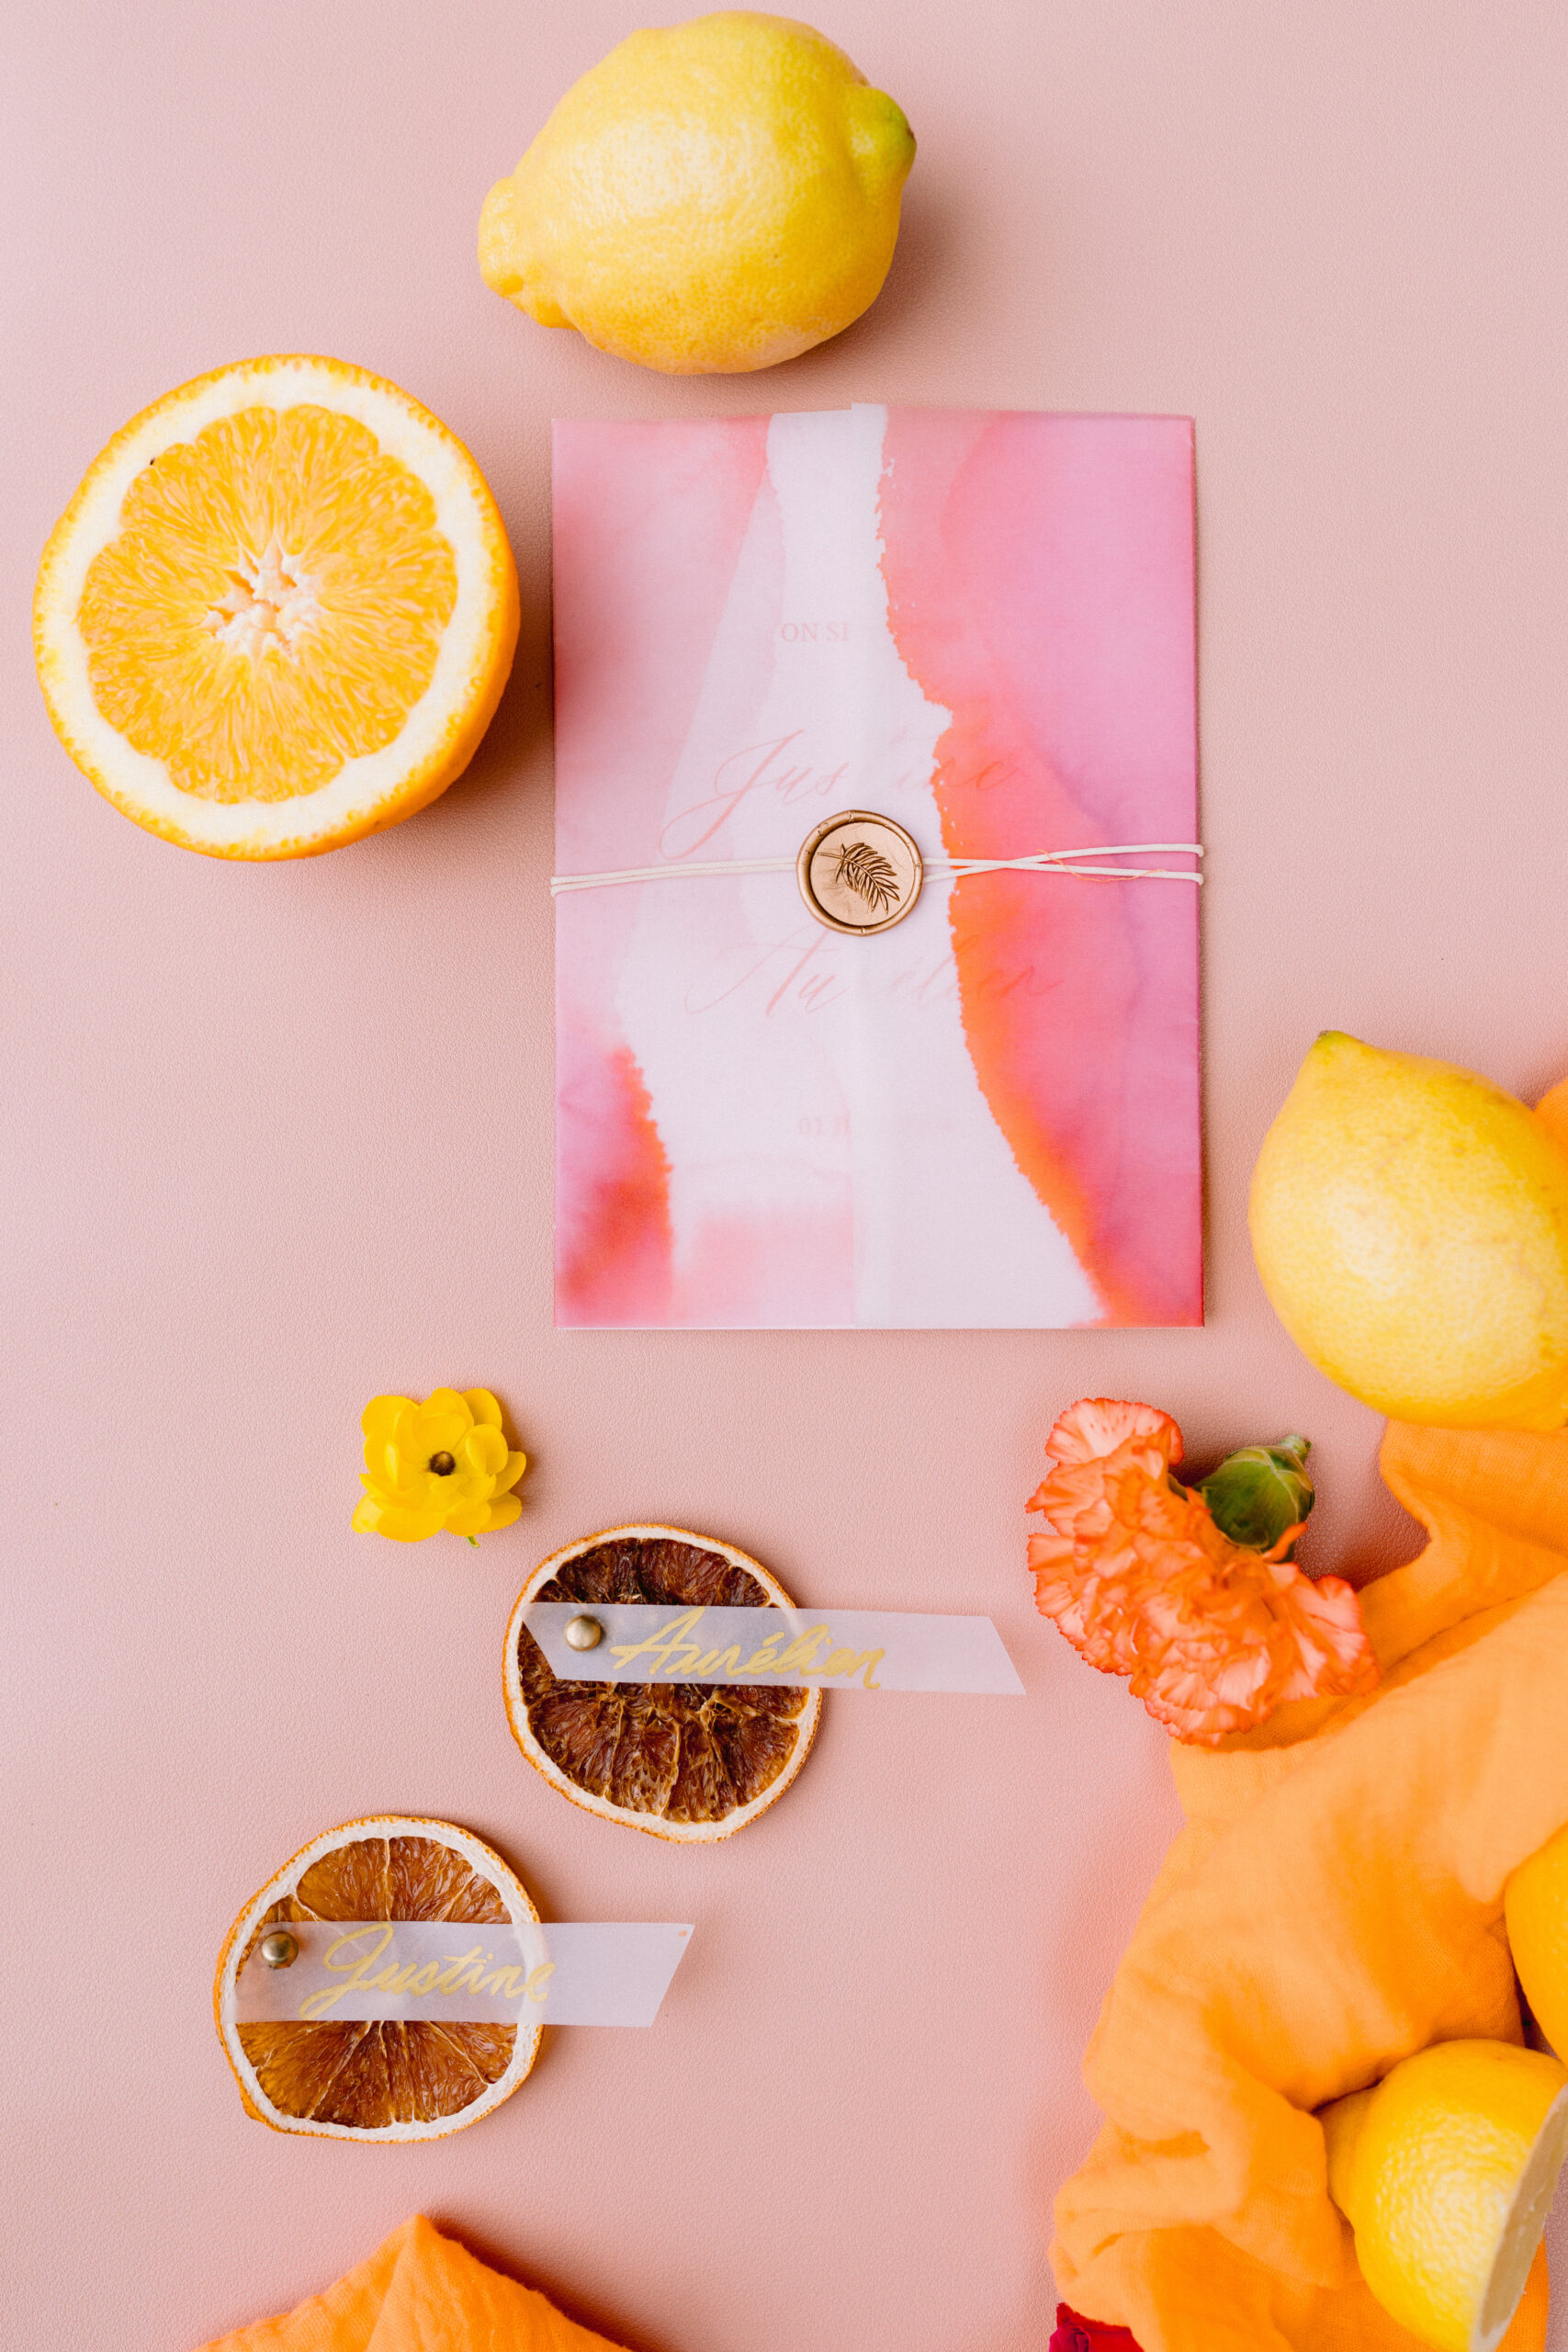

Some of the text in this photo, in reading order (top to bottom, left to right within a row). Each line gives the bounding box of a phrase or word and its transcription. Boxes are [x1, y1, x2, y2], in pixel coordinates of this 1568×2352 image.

[781, 623, 819, 642] ON
[609, 1606, 886, 1690] Aurélien
[299, 1921, 557, 2021] Justine
